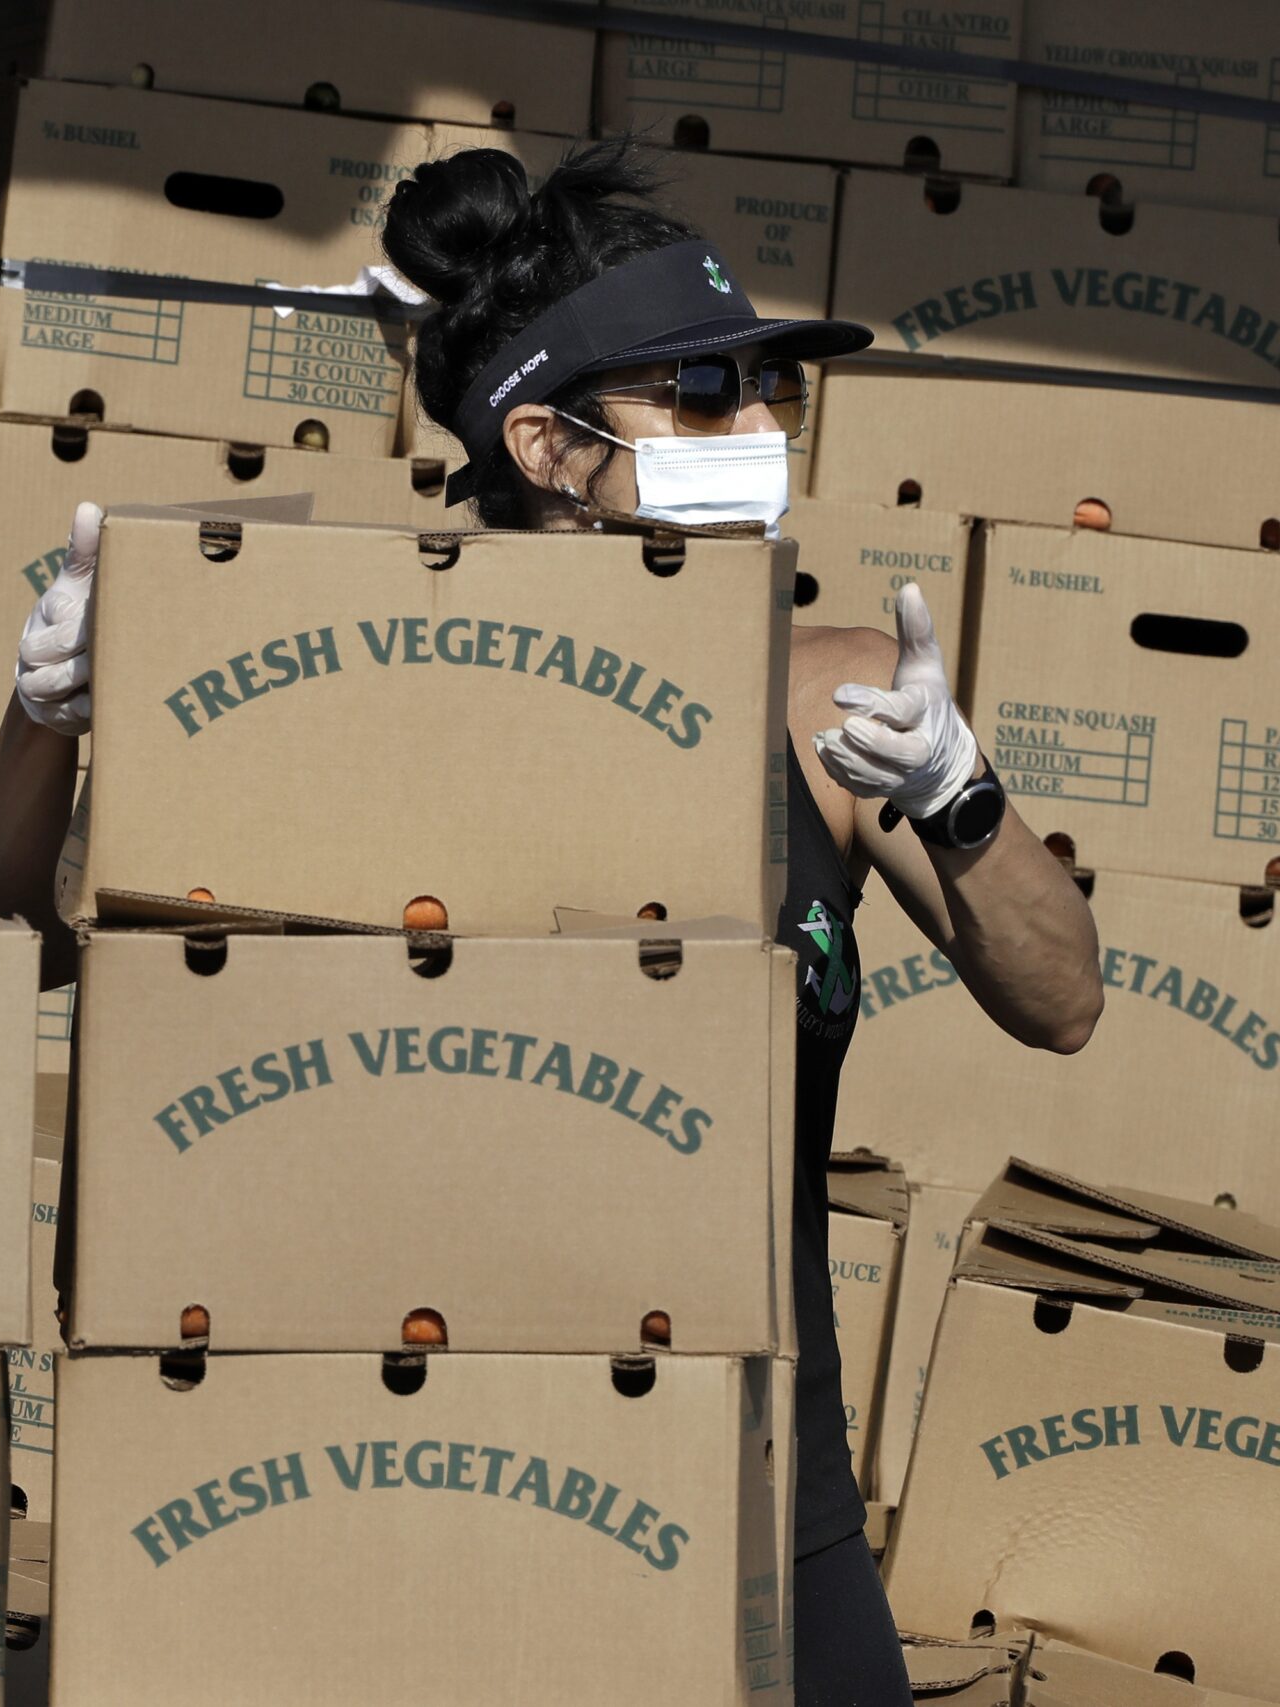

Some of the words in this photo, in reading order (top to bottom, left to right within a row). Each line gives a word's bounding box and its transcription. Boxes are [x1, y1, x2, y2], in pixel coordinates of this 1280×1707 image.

[902, 9, 1010, 33] CILANTRO
[1044, 44, 1105, 64] YELLOW
[628, 57, 700, 79] LARGE
[898, 78, 969, 102] OTHER
[62, 123, 141, 150] BUSHEL
[1041, 114, 1113, 136] LARGE
[329, 157, 412, 182] PRODUC
[733, 196, 829, 224] PRODUCE
[764, 224, 792, 242] OF
[755, 246, 795, 268] USA
[23, 302, 113, 330] MEDIUM
[295, 312, 376, 340] RADISH
[890, 269, 1038, 352] FRESH
[1050, 268, 1280, 370] VEGETABL
[22, 325, 96, 350] LARGE
[292, 334, 313, 355] 12
[316, 337, 390, 366] COUNT
[289, 358, 311, 378] 15
[313, 361, 388, 389] COUNT
[489, 370, 522, 408] CHOOSE
[520, 349, 549, 376] HOPE
[286, 382, 308, 400] 30
[310, 384, 385, 413] COUNT
[859, 549, 953, 574] PRODUCE
[1028, 569, 1105, 594] BUSHEL
[164, 626, 342, 738] FRESH
[358, 617, 713, 750] VEGETABLES
[998, 701, 1070, 725] GREEN
[1073, 709, 1157, 734] SQUASH
[996, 725, 1065, 748] SMALL
[995, 748, 1082, 773] MEDIUM
[999, 772, 1064, 794] ARGE
[1261, 798, 1279, 815] 15
[1257, 821, 1278, 839] 30
[861, 948, 959, 1019] FRES
[1103, 947, 1280, 1070] ETABLES
[153, 1038, 333, 1153] FRESH
[349, 1026, 713, 1155] VEGETABLES
[980, 1404, 1141, 1480] FRESH
[132, 1453, 311, 1569] FRESH
[326, 1439, 690, 1572] VEGETABLES
